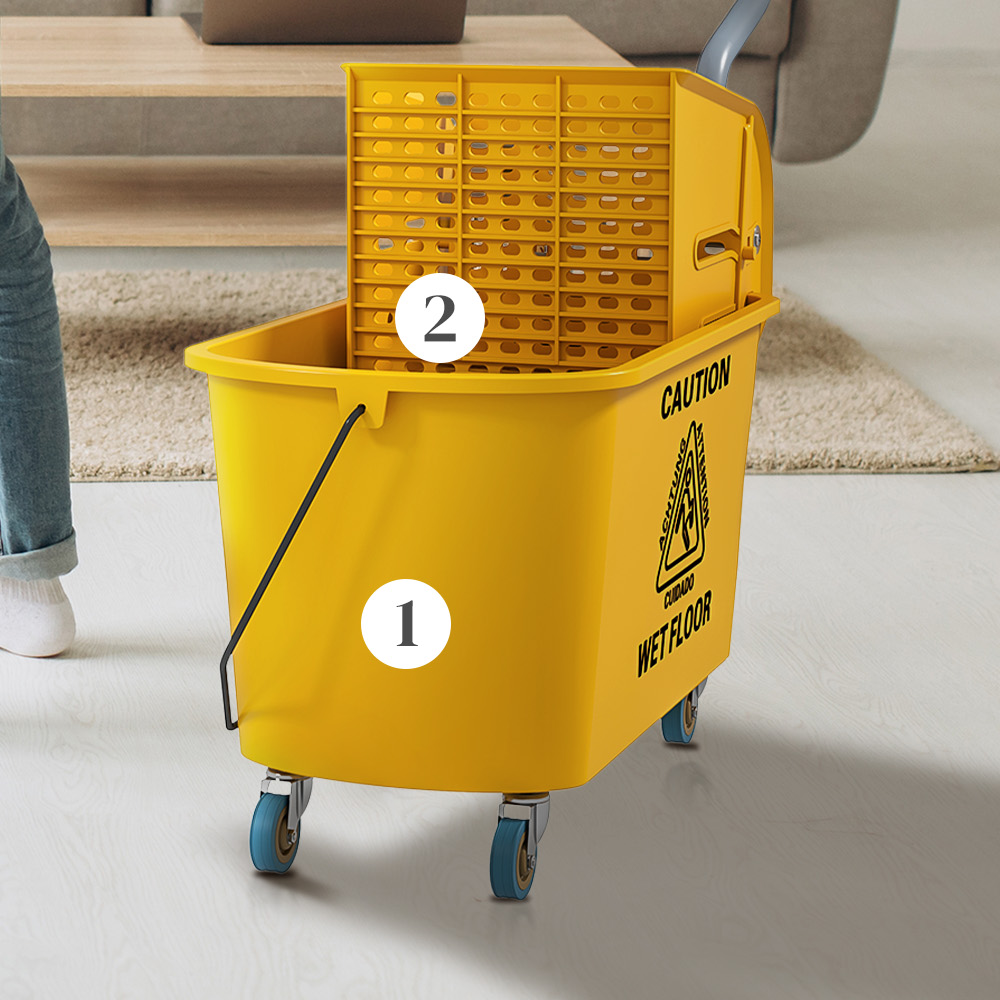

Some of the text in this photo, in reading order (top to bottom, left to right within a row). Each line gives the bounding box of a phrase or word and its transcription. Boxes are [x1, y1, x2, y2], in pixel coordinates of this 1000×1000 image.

[661, 355, 731, 419] CAUTION
[659, 437, 687, 552] ACHTUNG
[664, 572, 695, 610] CUIDADO
[637, 589, 712, 678] WET FLOOR
